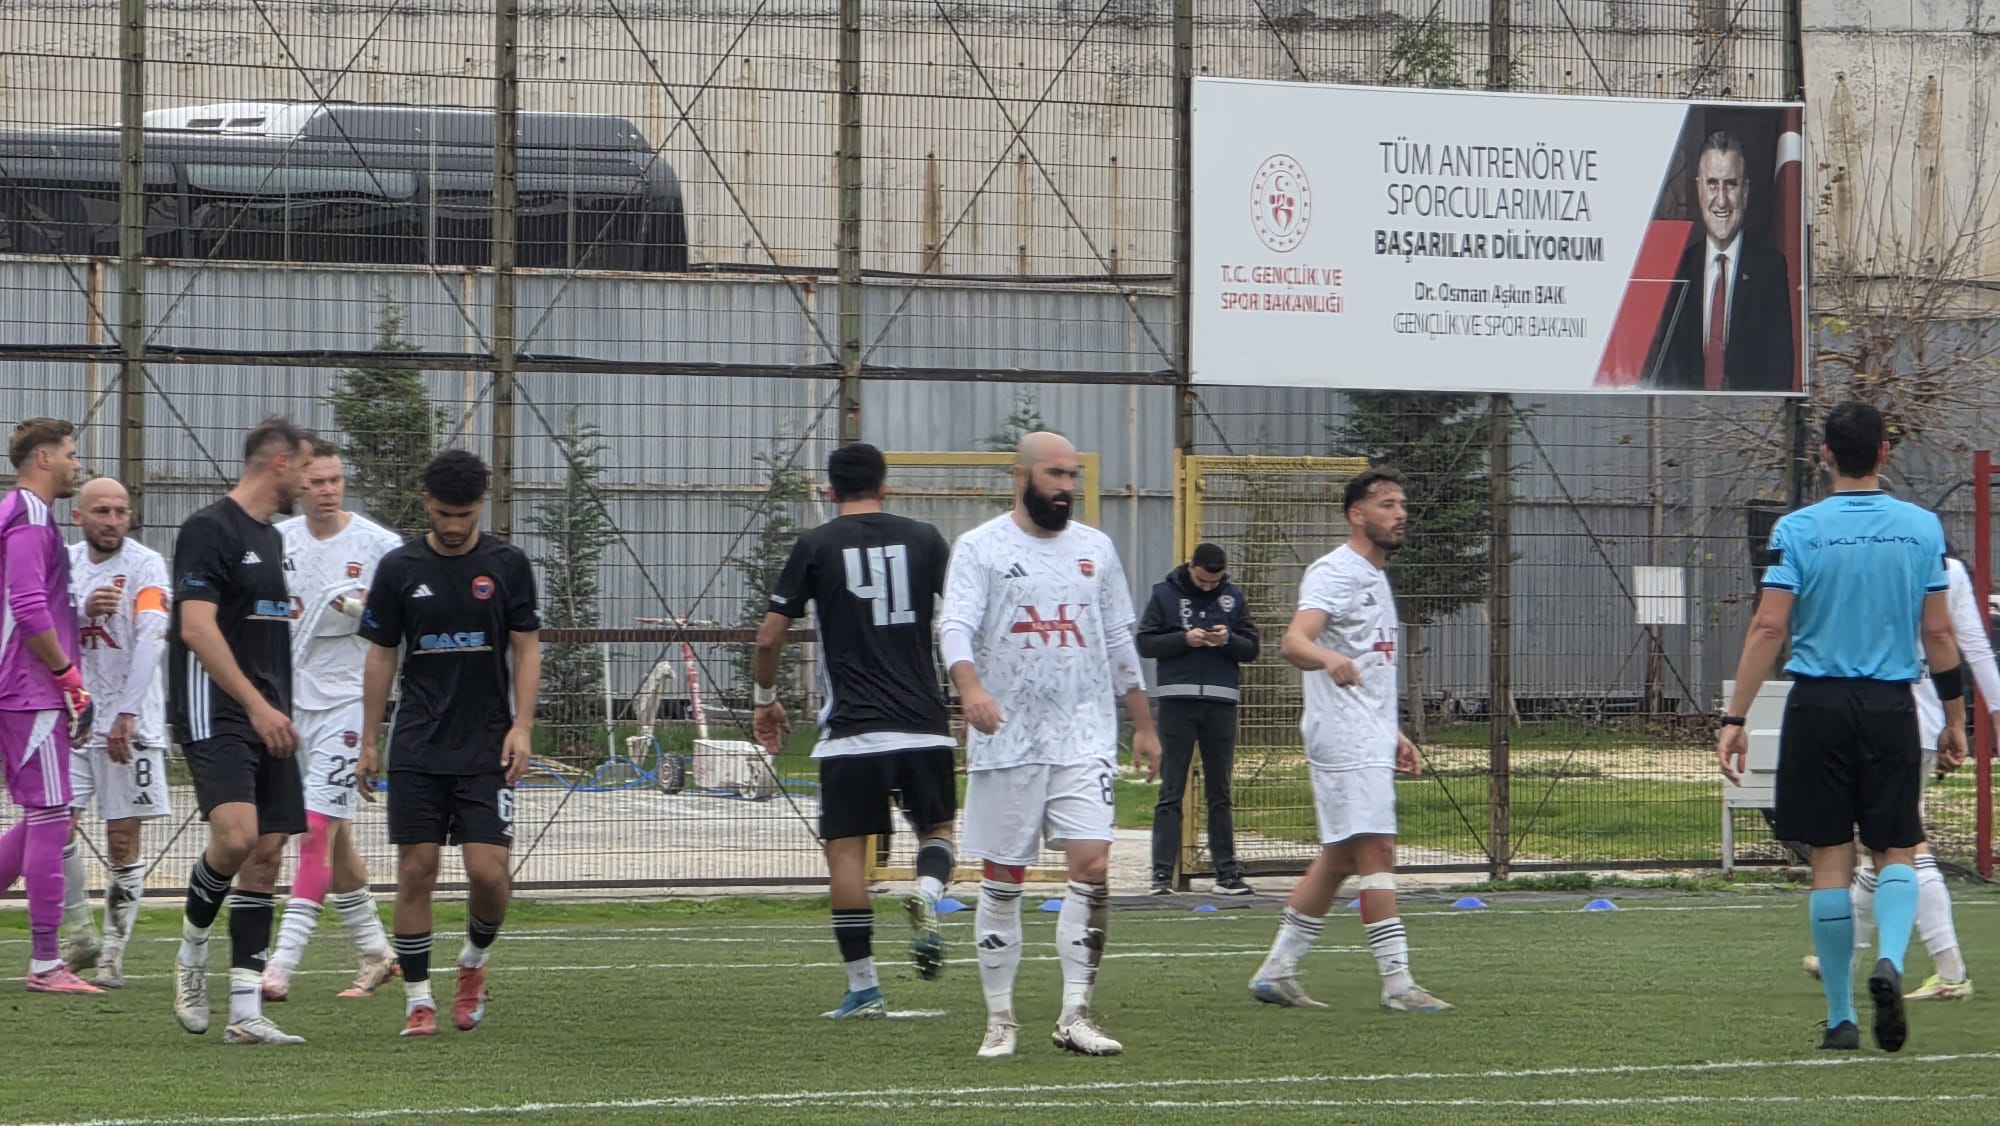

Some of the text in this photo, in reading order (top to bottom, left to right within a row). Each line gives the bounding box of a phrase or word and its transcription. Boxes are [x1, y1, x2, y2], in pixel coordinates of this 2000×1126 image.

[1378, 136, 1598, 181] TÜM ANTRENÖR VE
[1387, 183, 1592, 222] SPORCULARIMIZA
[1374, 228, 1605, 263] BAŞARILAR DİLİYORUM
[1220, 263, 1343, 289] T.C. GENÇLİK VE
[1220, 291, 1344, 313] SPOR BAKANLIĞI
[1414, 281, 1568, 308] Dr. Osman Aşkın BAK
[1393, 310, 1588, 340] GENÇLİK VE SPOR BAKANI
[842, 544, 915, 626] 41
[1180, 598, 1193, 630] POL
[135, 757, 152, 788] 8
[497, 787, 514, 823] 6
